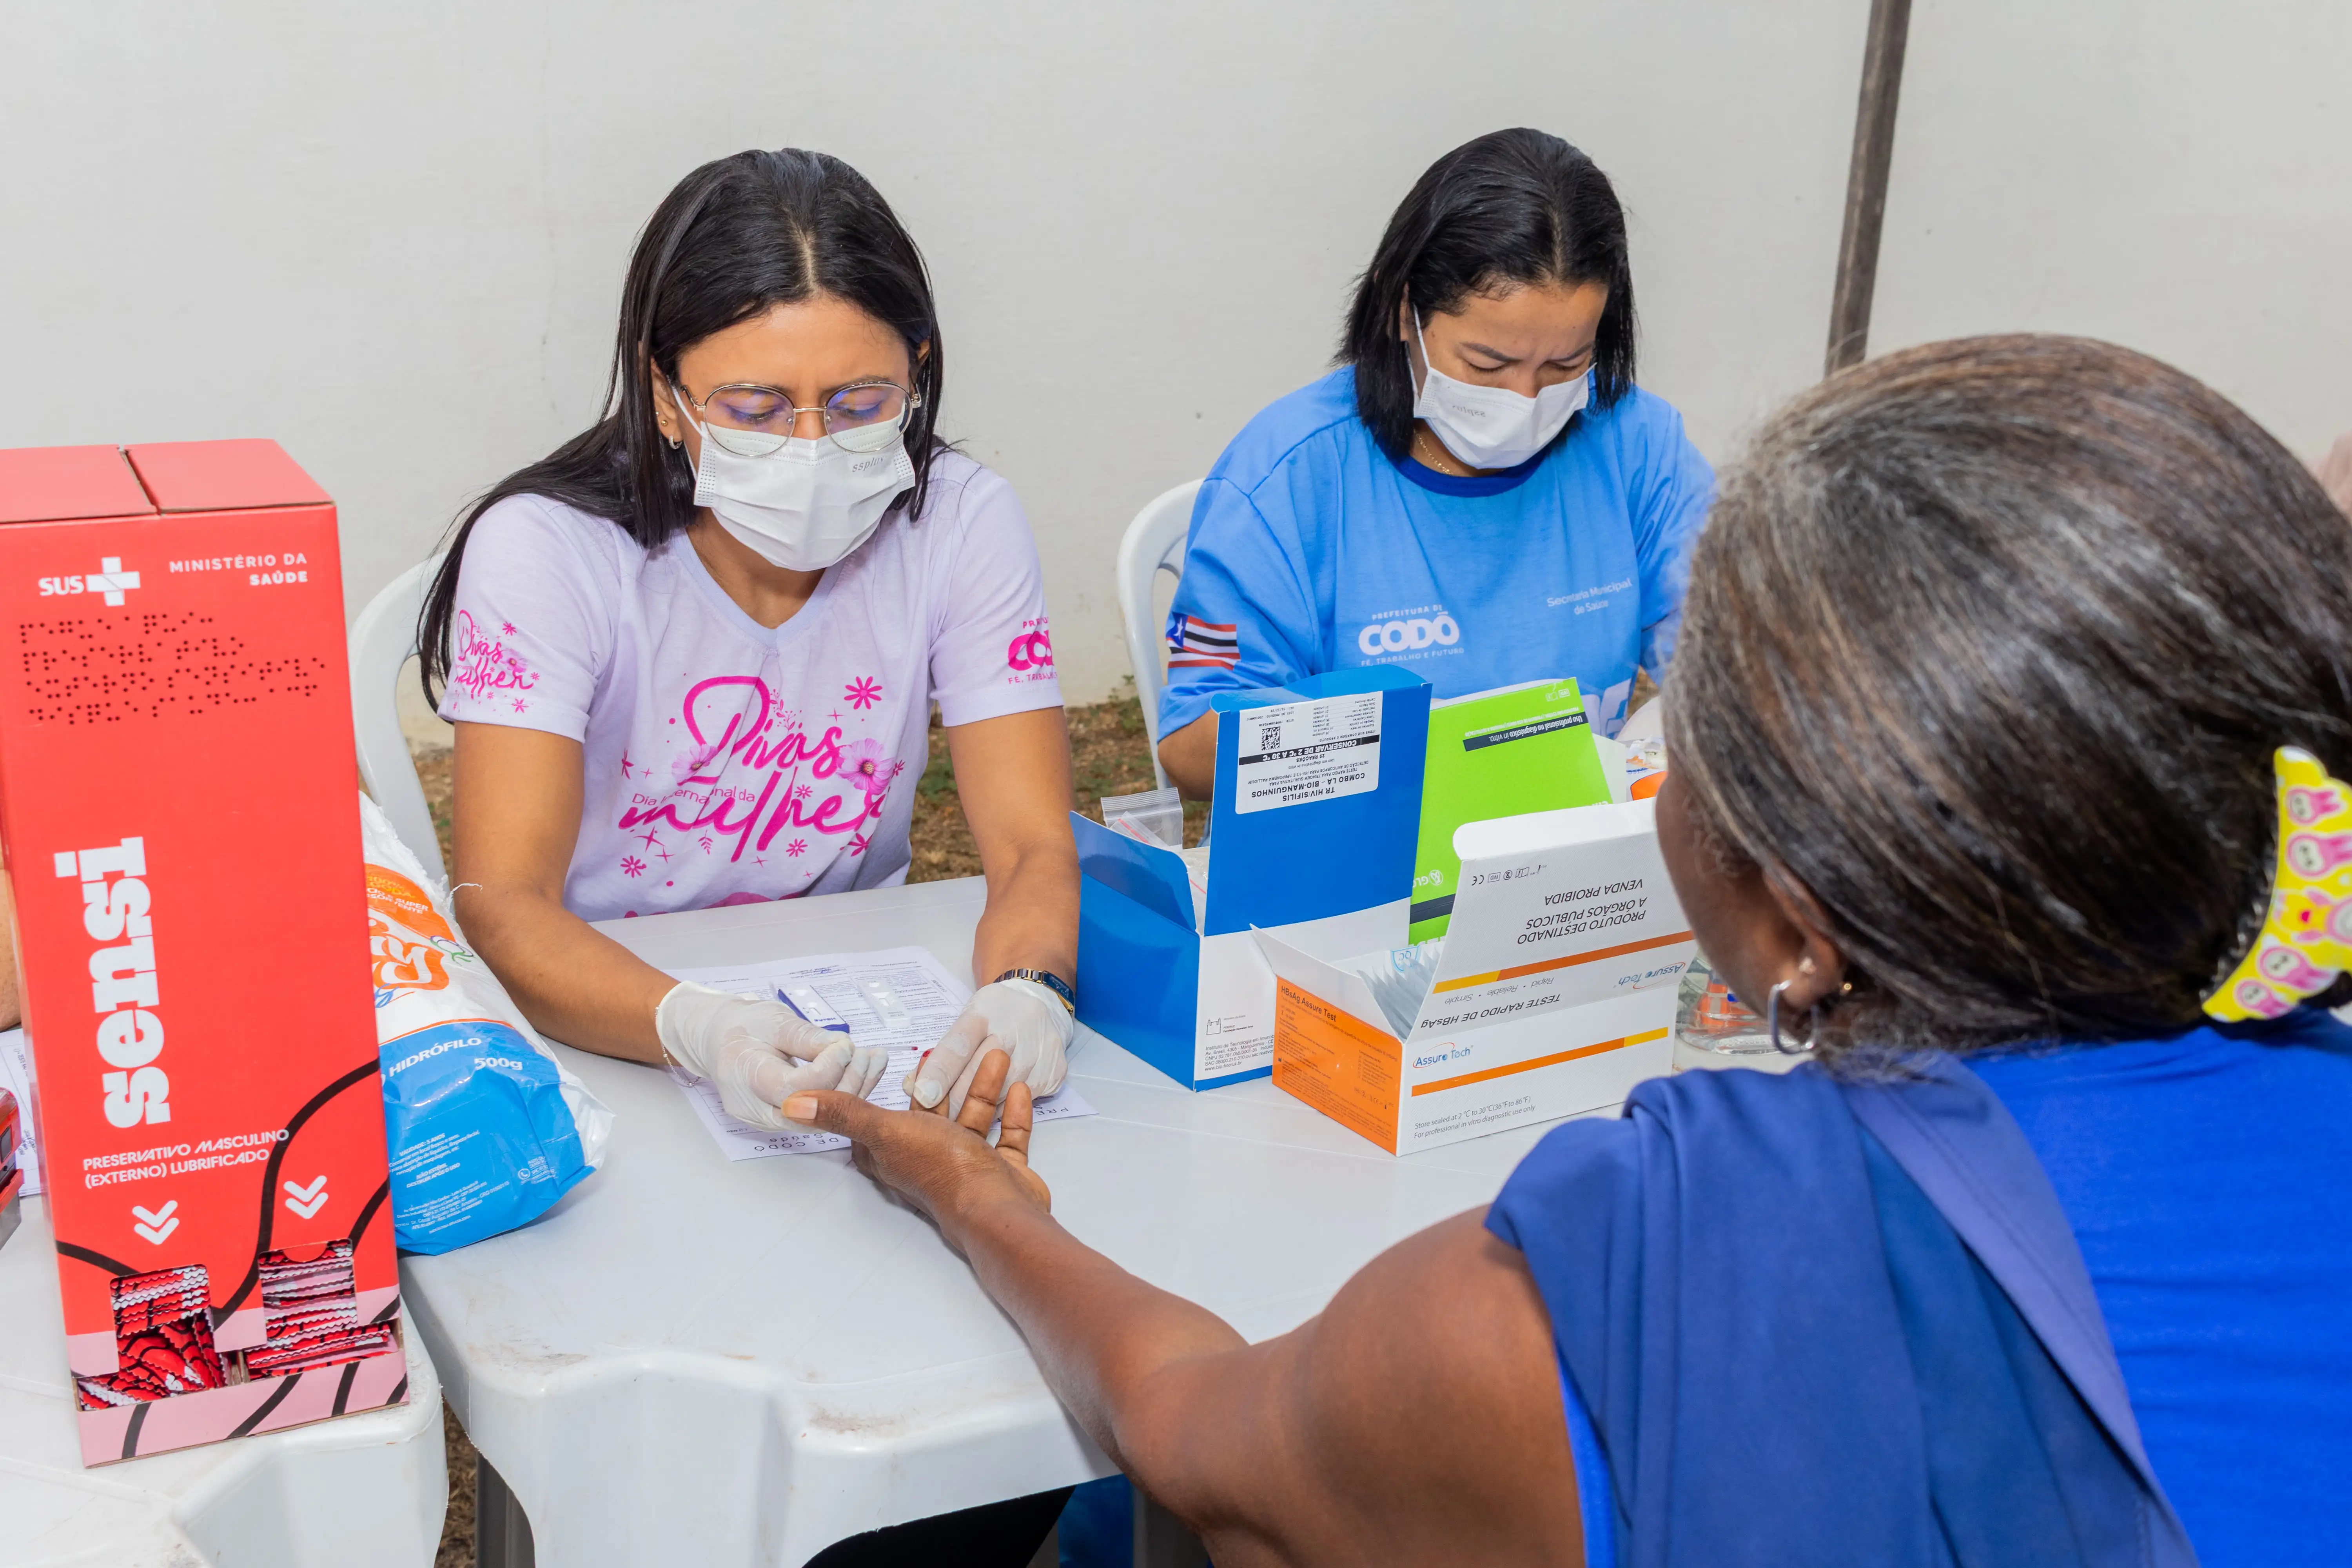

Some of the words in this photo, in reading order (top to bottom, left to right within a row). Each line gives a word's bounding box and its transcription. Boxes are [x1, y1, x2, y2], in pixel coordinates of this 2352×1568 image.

[169, 554, 276, 573] MINISTÉRIO
[283, 553, 307, 565] DA
[38, 576, 84, 595] SUS
[249, 570, 308, 586] SAÚDE
[1547, 589, 1590, 608] Secretaria
[1590, 577, 1632, 597] Municipal
[1372, 606, 1430, 621] PREFEITURA
[1574, 605, 1584, 615] de
[1376, 653, 1422, 665] TRABALHO
[1432, 647, 1465, 657] FUTURO
[1544, 716, 1573, 731] profissional
[1572, 715, 1583, 724] Uso
[678, 676, 843, 786] Divas
[1488, 733, 1503, 744] vitro.
[1503, 732, 1510, 740] in
[1508, 724, 1538, 739] diagnóstico
[1315, 739, 1357, 750] CONSERVAR
[1296, 754, 1318, 762] REAÇÕES
[1338, 772, 1365, 782] COMBO
[1251, 780, 1320, 798] BIO-MANGUINHOS
[1282, 789, 1323, 801] HIV/SIFILIS
[632, 793, 657, 805] Dia
[739, 789, 755, 802] da
[1604, 879, 1643, 895] VENDA
[394, 896, 428, 912] SUPER
[1544, 887, 1601, 906] PROIBIDA
[1639, 897, 1648, 907] A
[1587, 900, 1637, 919] ÓRGÃOS
[1526, 909, 1584, 929] PÚBLICOS
[1589, 910, 1647, 930] PRODUTO
[1517, 922, 1586, 945] DESTINADO
[1618, 972, 1642, 985] Tech
[1645, 964, 1682, 978] Assure
[54, 837, 171, 1128] sensi
[1487, 984, 1518, 996] Reliable
[1531, 977, 1554, 989] Rapid
[1281, 985, 1300, 1004] HBsAg
[1301, 996, 1322, 1013] Assure
[1324, 1007, 1336, 1022] Test
[1445, 993, 1474, 1005] Simple
[1526, 993, 1560, 1009] TESTE
[1461, 1011, 1478, 1022] DE
[1480, 1000, 1523, 1019] RÁPIDO
[1421, 1014, 1458, 1029] HBsAg
[1240, 1041, 1265, 1049] Manguinhos
[388, 1037, 482, 1077] HIDRÓFILO
[474, 1058, 523, 1071] 500g
[1414, 1053, 1449, 1067] Assure
[1450, 1047, 1470, 1060] Tech
[1204, 1061, 1242, 1071] www.bio.fiocruz.br
[1413, 1130, 1425, 1139] For
[1424, 1122, 1461, 1137] professional
[1466, 1118, 1481, 1126] vitro
[1481, 1111, 1512, 1124] diagnostic
[1523, 1104, 1536, 1114] only
[1414, 1120, 1430, 1129] Store
[1430, 1115, 1450, 1125] sealed
[769, 1132, 824, 1143] Saúde
[83, 1143, 191, 1171] PRESERVATIVO
[195, 1129, 289, 1153] MASCULINO
[754, 1141, 806, 1151] CODÓ
[84, 1162, 167, 1189] (EXTERNO)
[171, 1149, 269, 1174] LUBRIFICADO
[448, 1161, 461, 1171] USO
